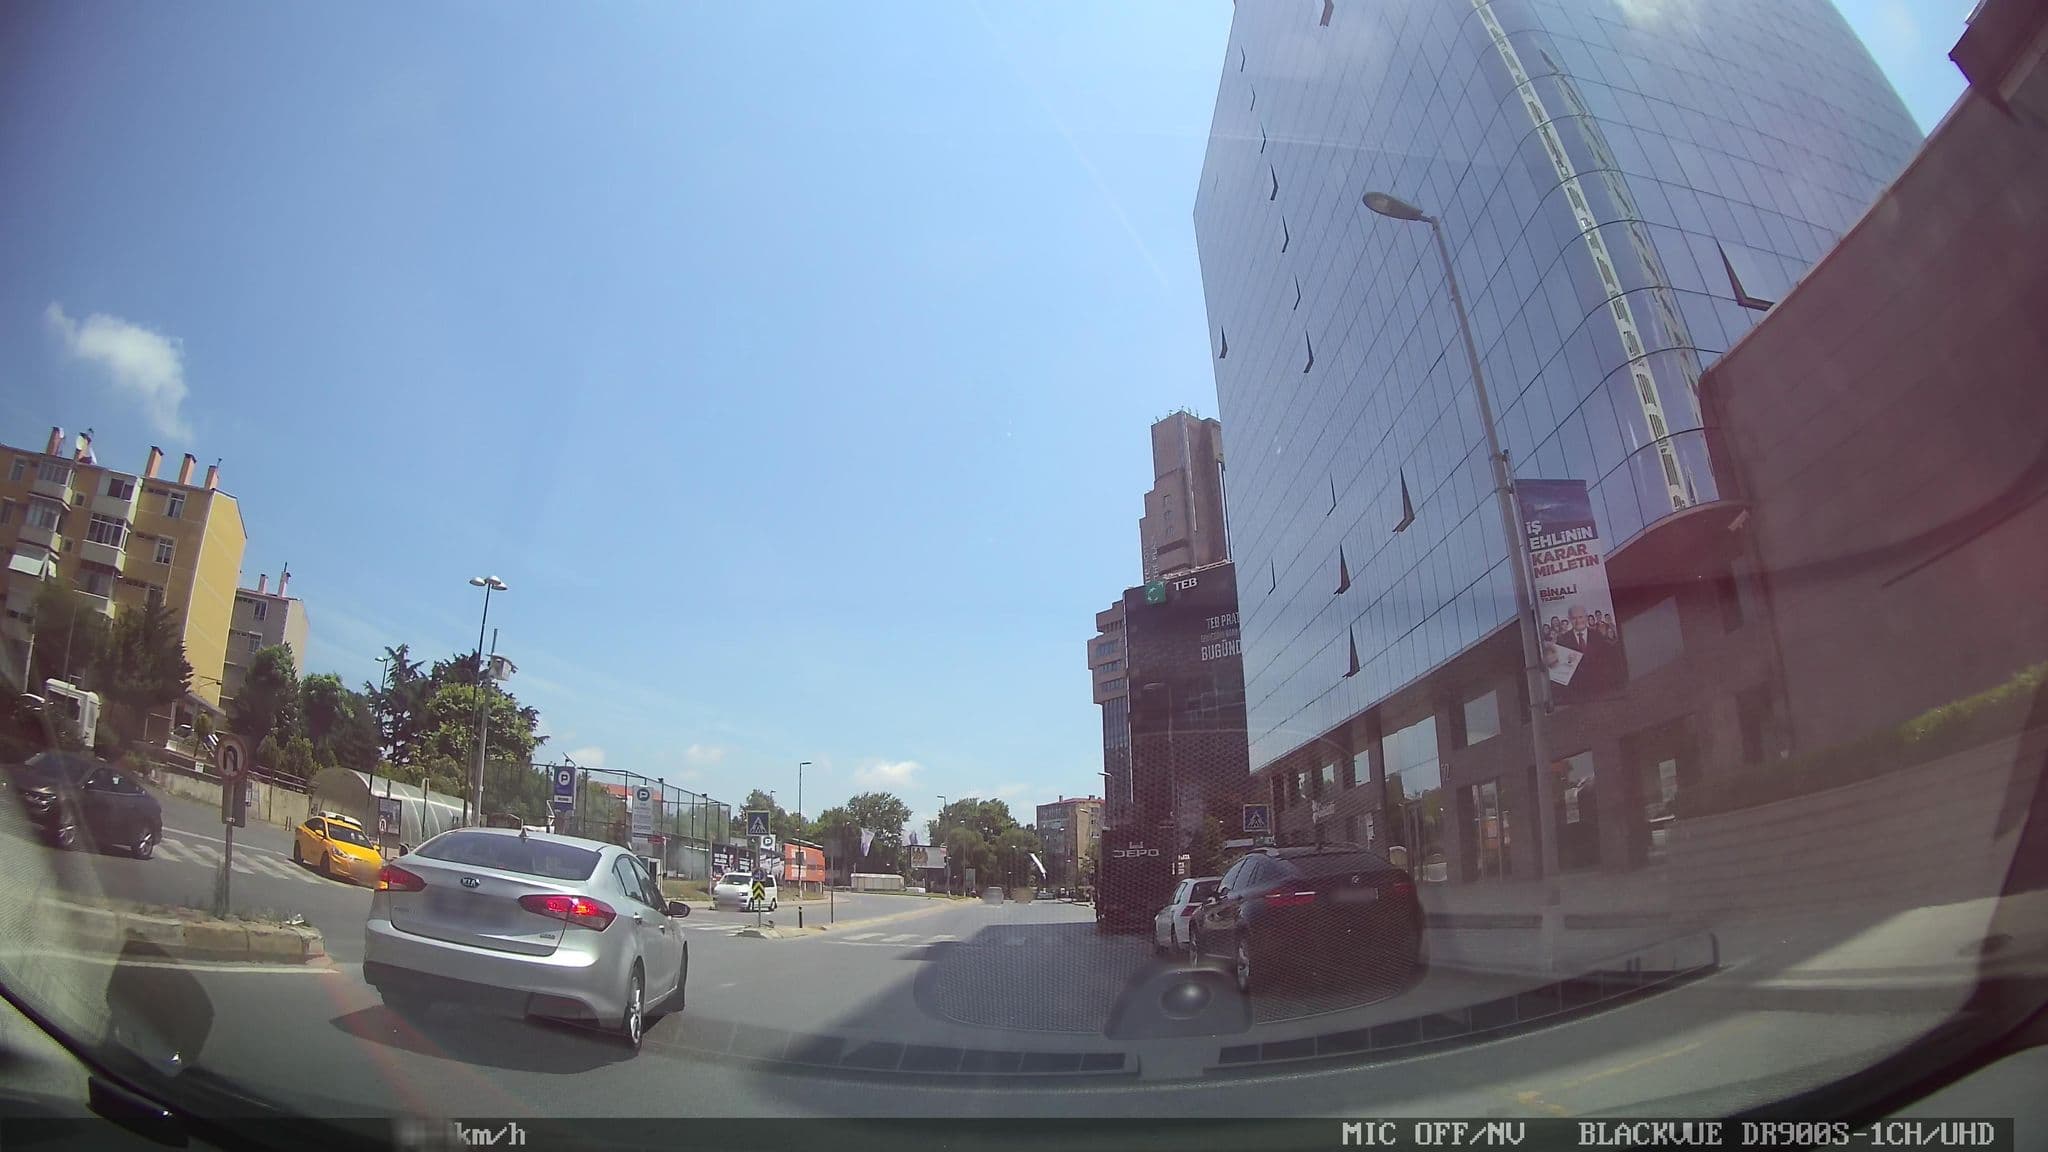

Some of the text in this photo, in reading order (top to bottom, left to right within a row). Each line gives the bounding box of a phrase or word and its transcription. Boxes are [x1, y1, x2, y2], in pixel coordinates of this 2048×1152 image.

[1525, 519, 1543, 535] İŞ
[1529, 526, 1593, 550] EHLİNİN
[1531, 543, 1587, 566] KARAR
[1533, 554, 1600, 578] MİLLETİN
[1173, 577, 1198, 591] TEB
[1539, 584, 1577, 598] BİNALİ
[1206, 616, 1220, 629] TEB
[1112, 848, 1160, 858] DEPO
[462, 877, 481, 888] KIA
